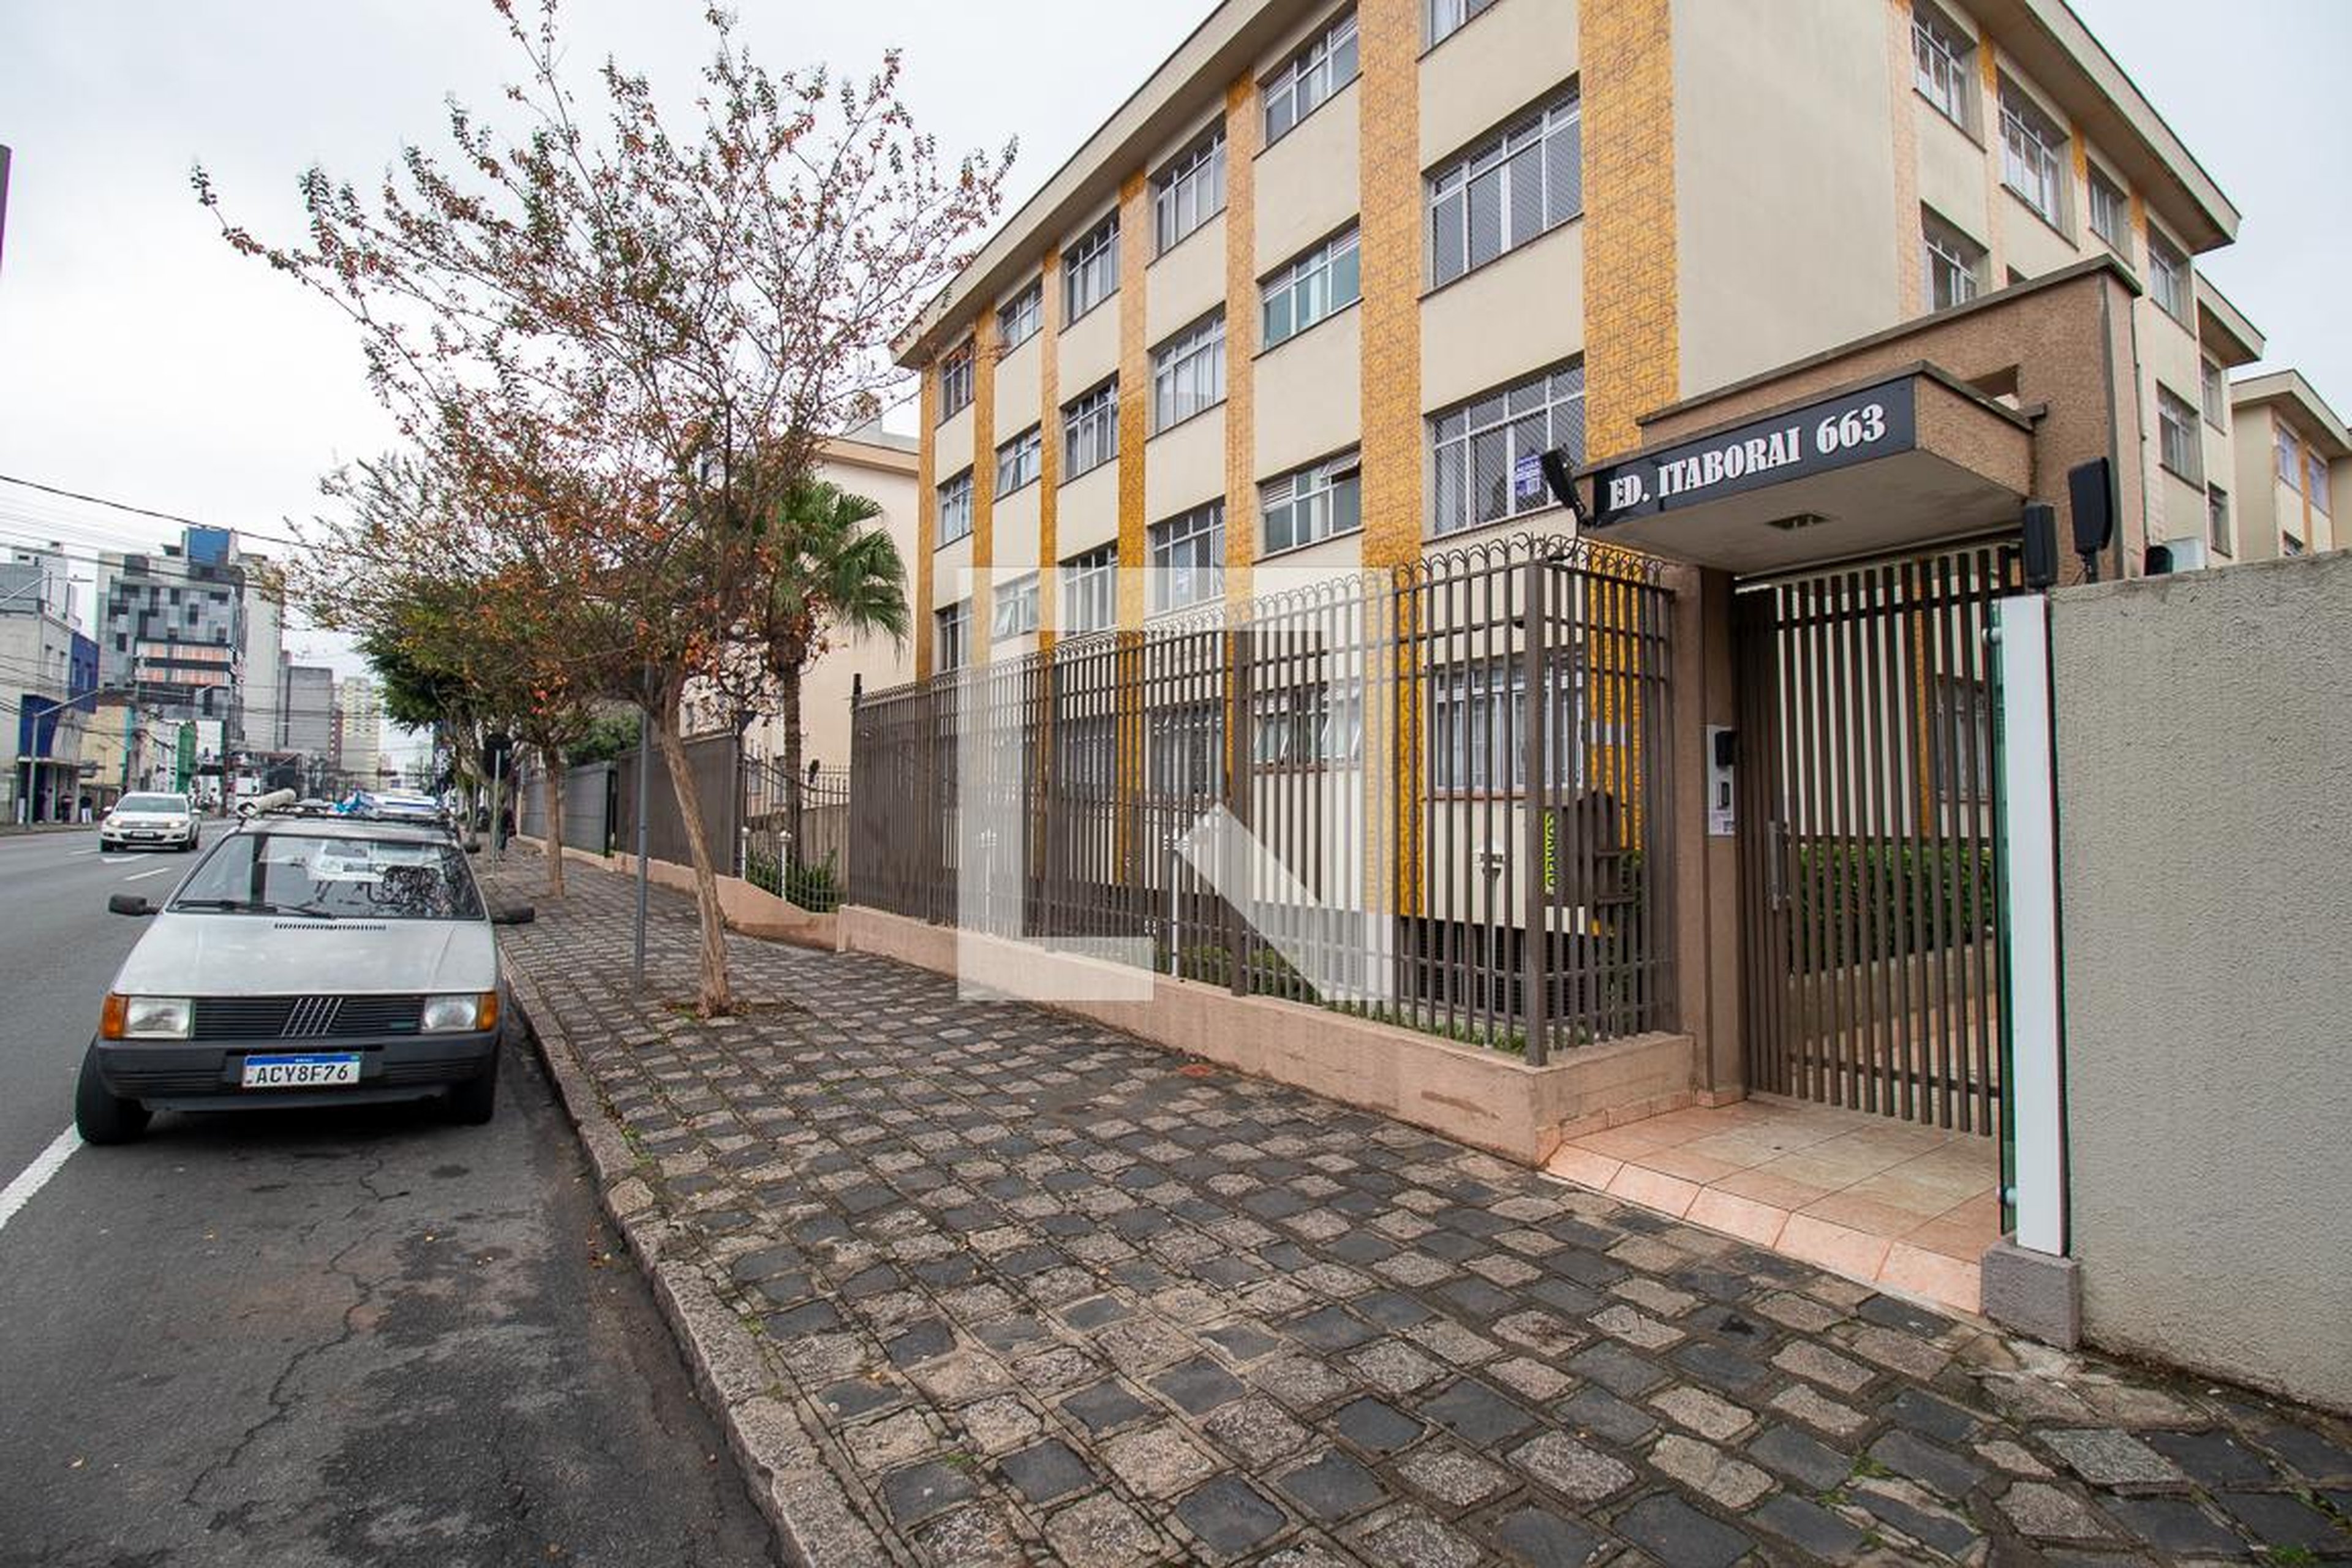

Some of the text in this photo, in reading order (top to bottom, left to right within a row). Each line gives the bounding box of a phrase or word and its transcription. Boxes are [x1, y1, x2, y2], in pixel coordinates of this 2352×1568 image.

[1608, 403, 1886, 511] ED. ITABORAI 663
[256, 1065, 349, 1084] ACY8F76
